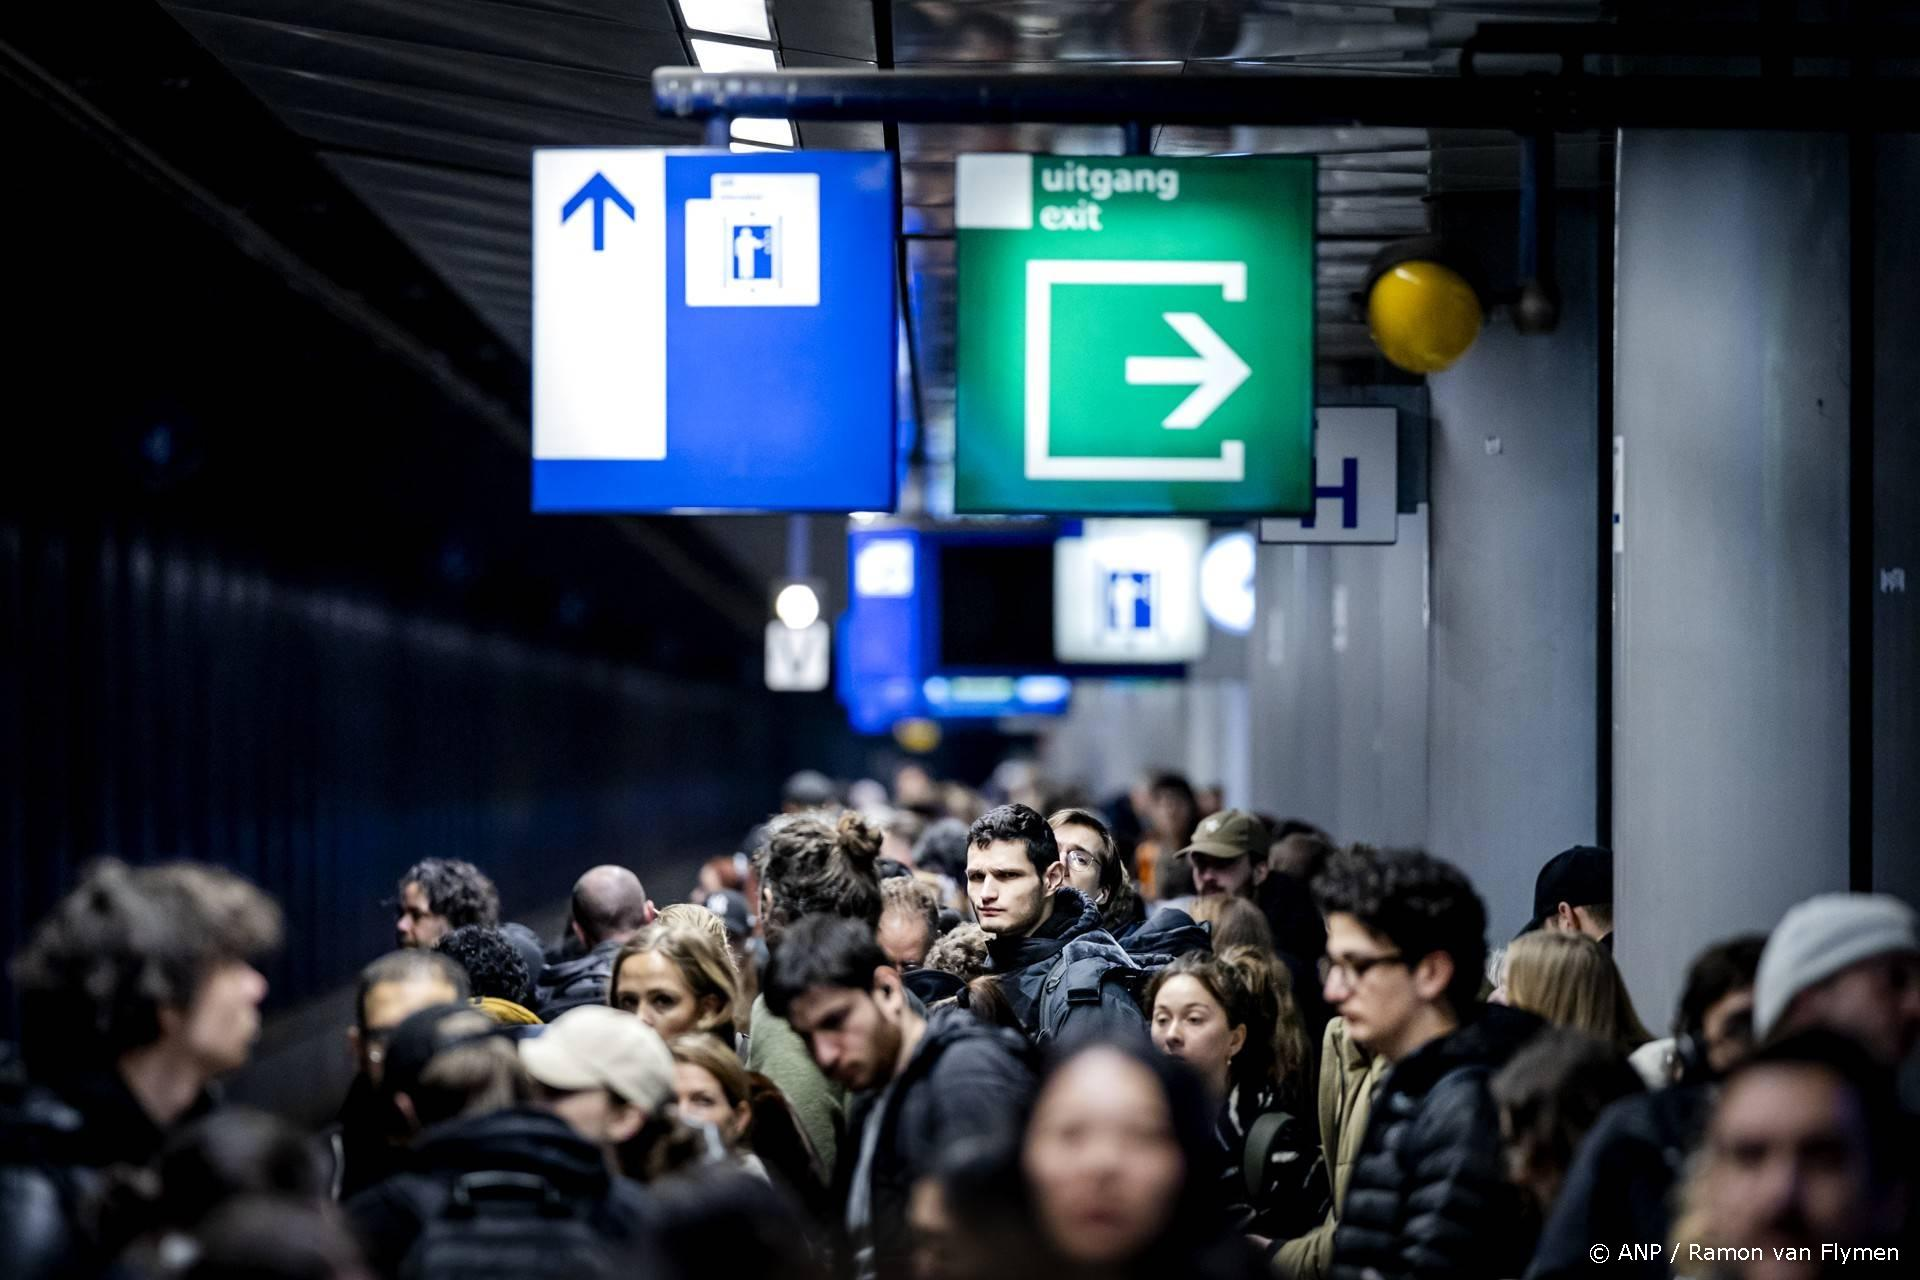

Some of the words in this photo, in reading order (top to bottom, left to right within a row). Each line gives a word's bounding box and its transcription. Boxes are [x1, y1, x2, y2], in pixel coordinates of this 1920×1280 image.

[1041, 161, 1179, 200] uitgang
[1039, 199, 1103, 231] exit
[1301, 457, 1358, 529] H
